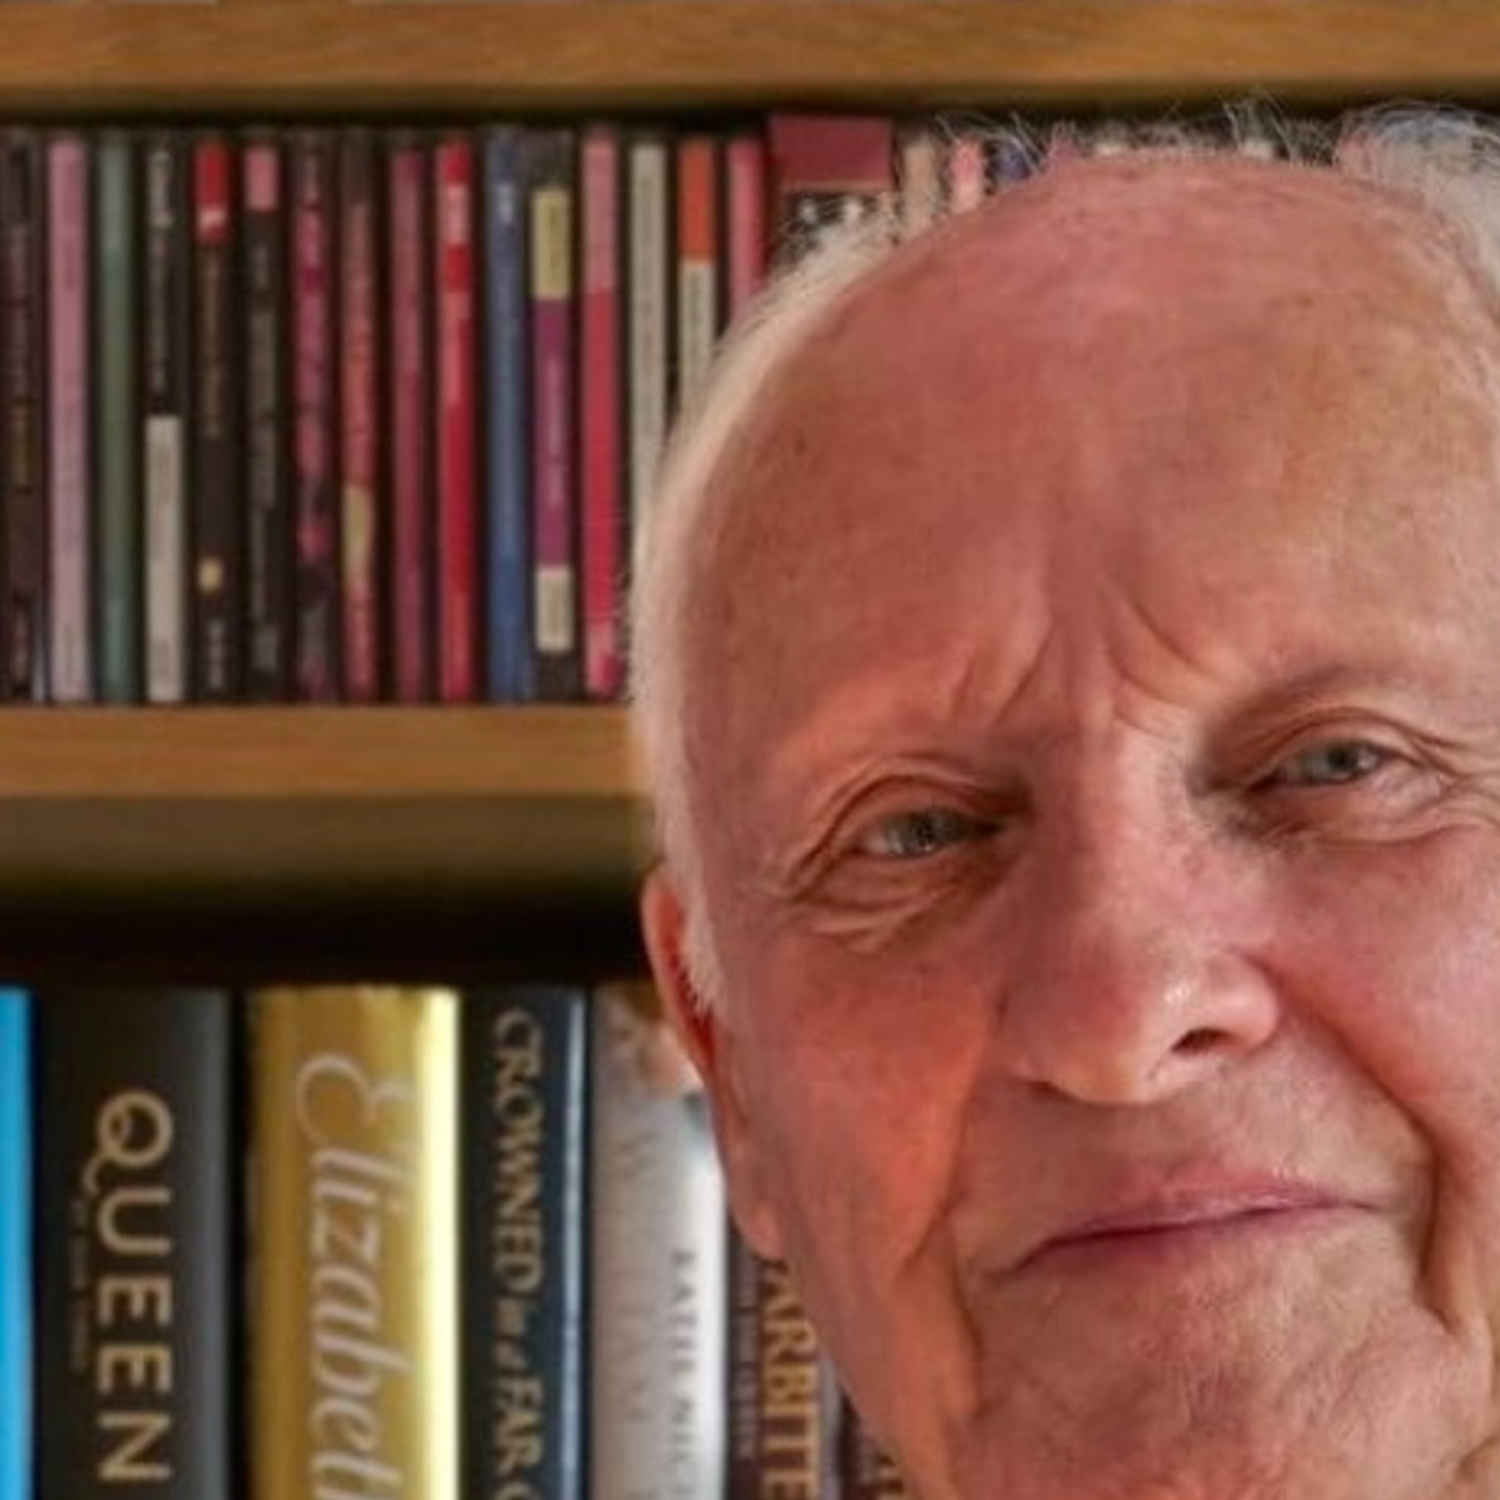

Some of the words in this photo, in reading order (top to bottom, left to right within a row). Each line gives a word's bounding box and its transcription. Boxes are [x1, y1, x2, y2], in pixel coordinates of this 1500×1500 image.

[493, 1006, 546, 1293] CROWNED
[82, 1089, 175, 1484] QUEEN
[668, 1249, 698, 1375] KATIE
[495, 1376, 546, 1475] FAR
